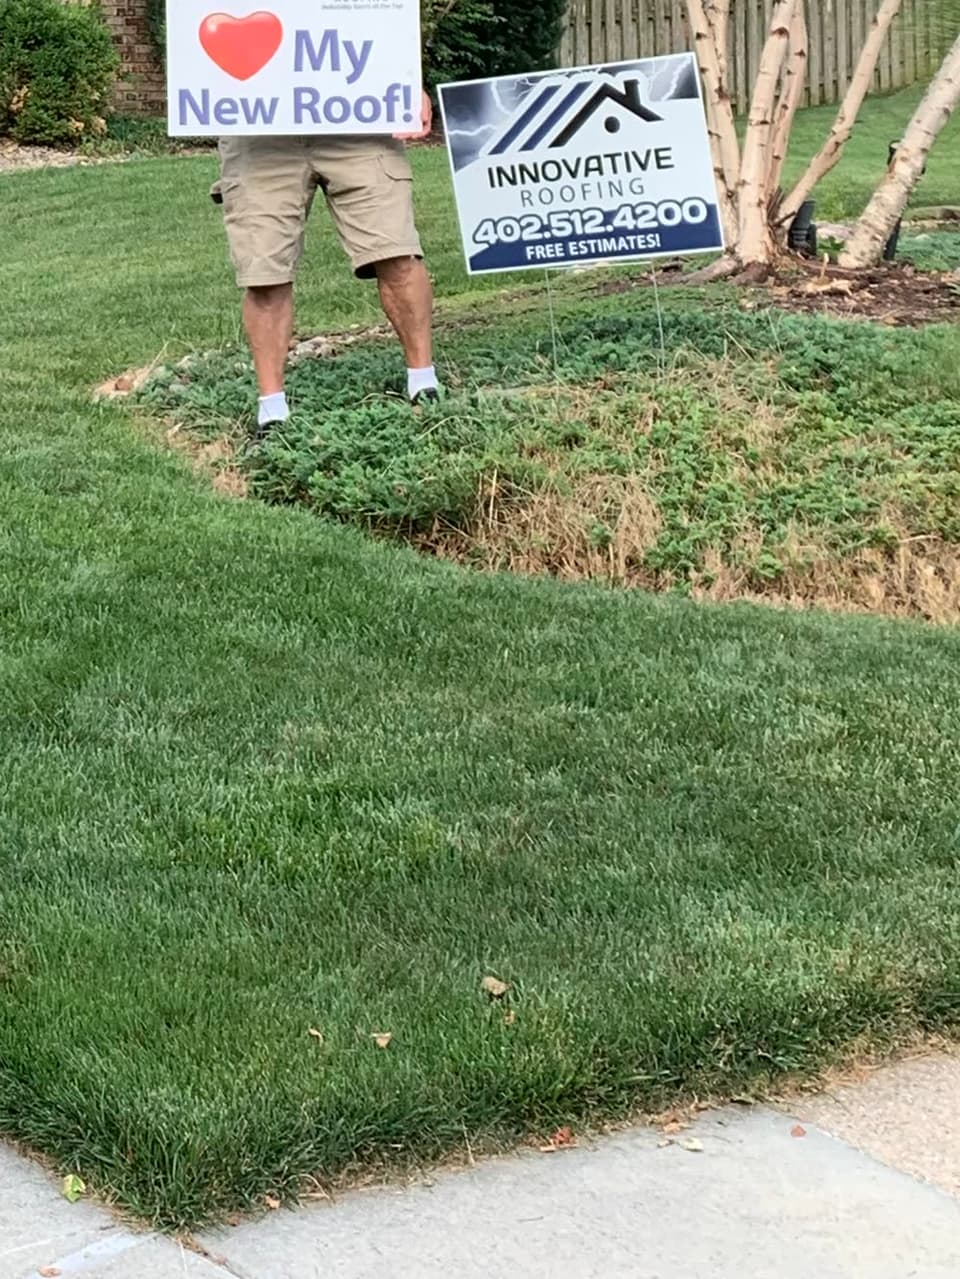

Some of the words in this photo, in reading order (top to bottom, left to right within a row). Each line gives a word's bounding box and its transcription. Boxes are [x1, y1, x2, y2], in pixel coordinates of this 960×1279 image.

[293, 29, 373, 84] My
[178, 88, 279, 126] New
[293, 83, 413, 124] Roof!
[488, 147, 675, 188] INNOVATIVE
[521, 177, 645, 208] ROOFING
[473, 197, 708, 245] 402.512.4200
[526, 243, 565, 261] FREE
[569, 233, 661, 256] ESTIMATES!
